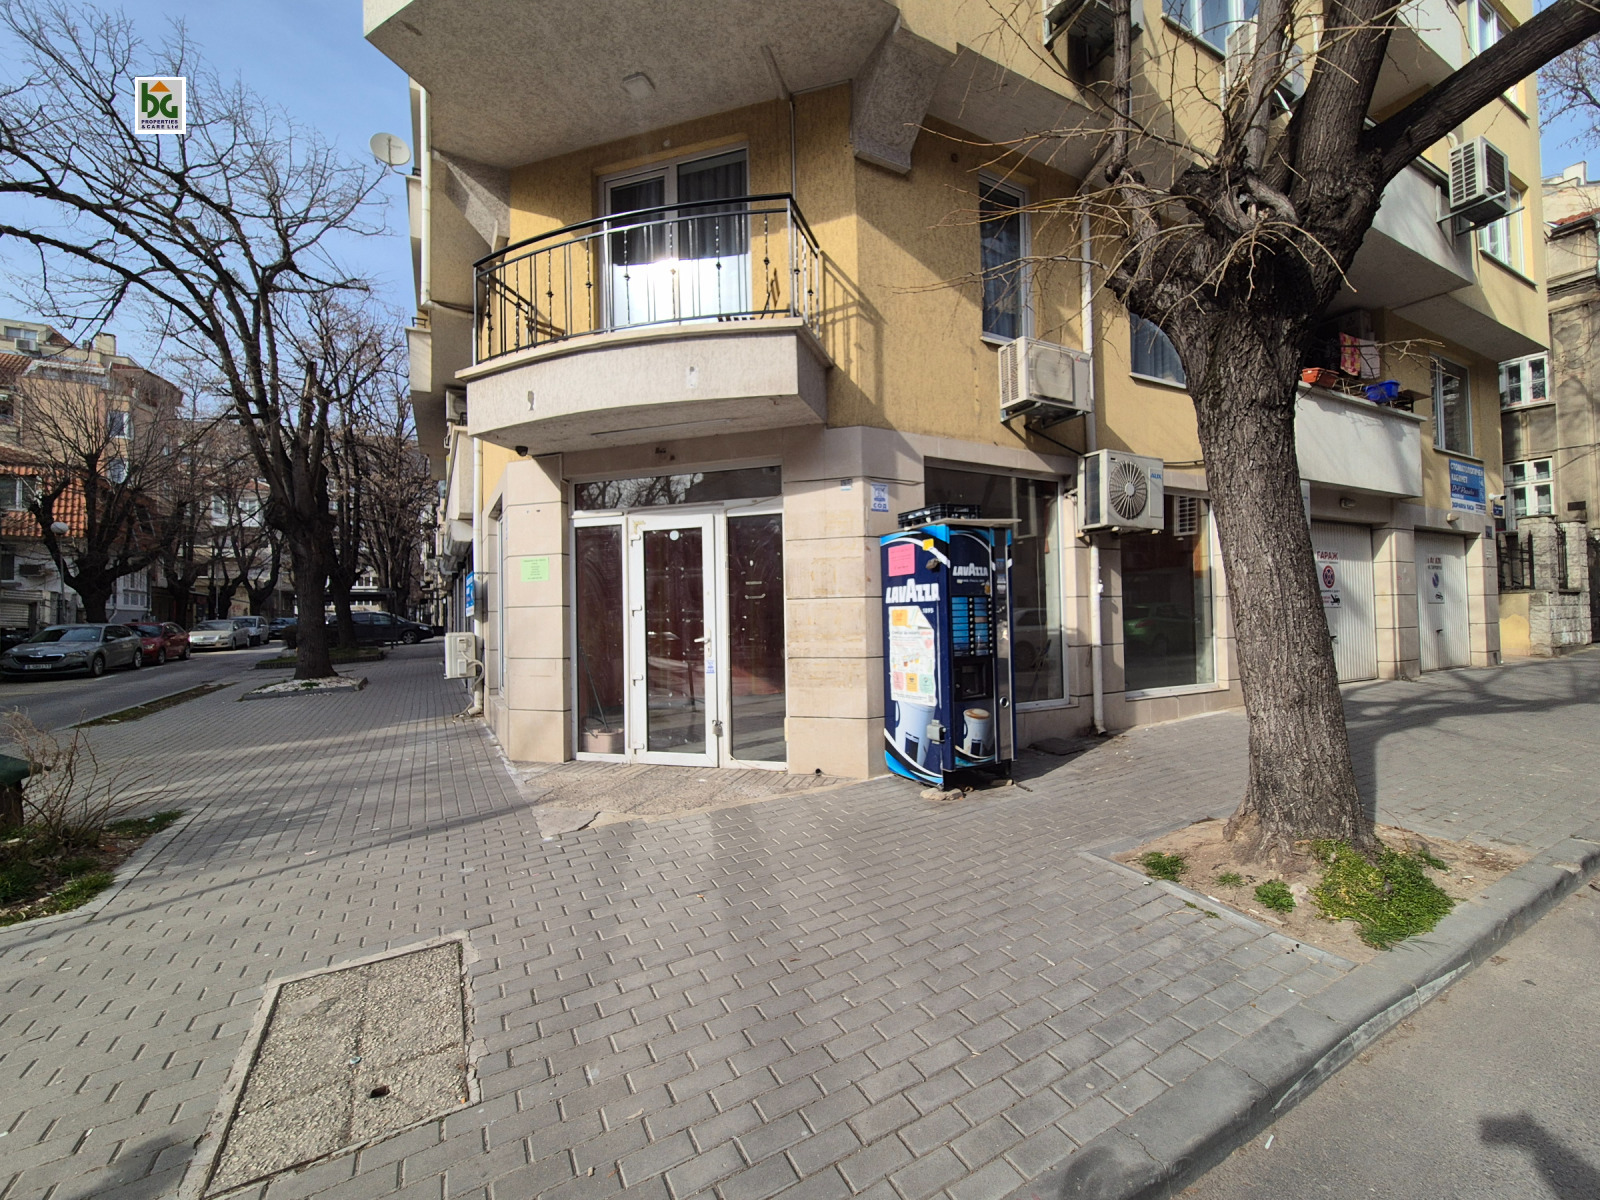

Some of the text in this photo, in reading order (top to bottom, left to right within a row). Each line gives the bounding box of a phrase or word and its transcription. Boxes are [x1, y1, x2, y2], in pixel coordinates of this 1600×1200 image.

[1316, 551, 1339, 560] ГАРАЖ
[952, 562, 989, 576] LAVAZZA
[885, 578, 940, 604] LAVAZZA
